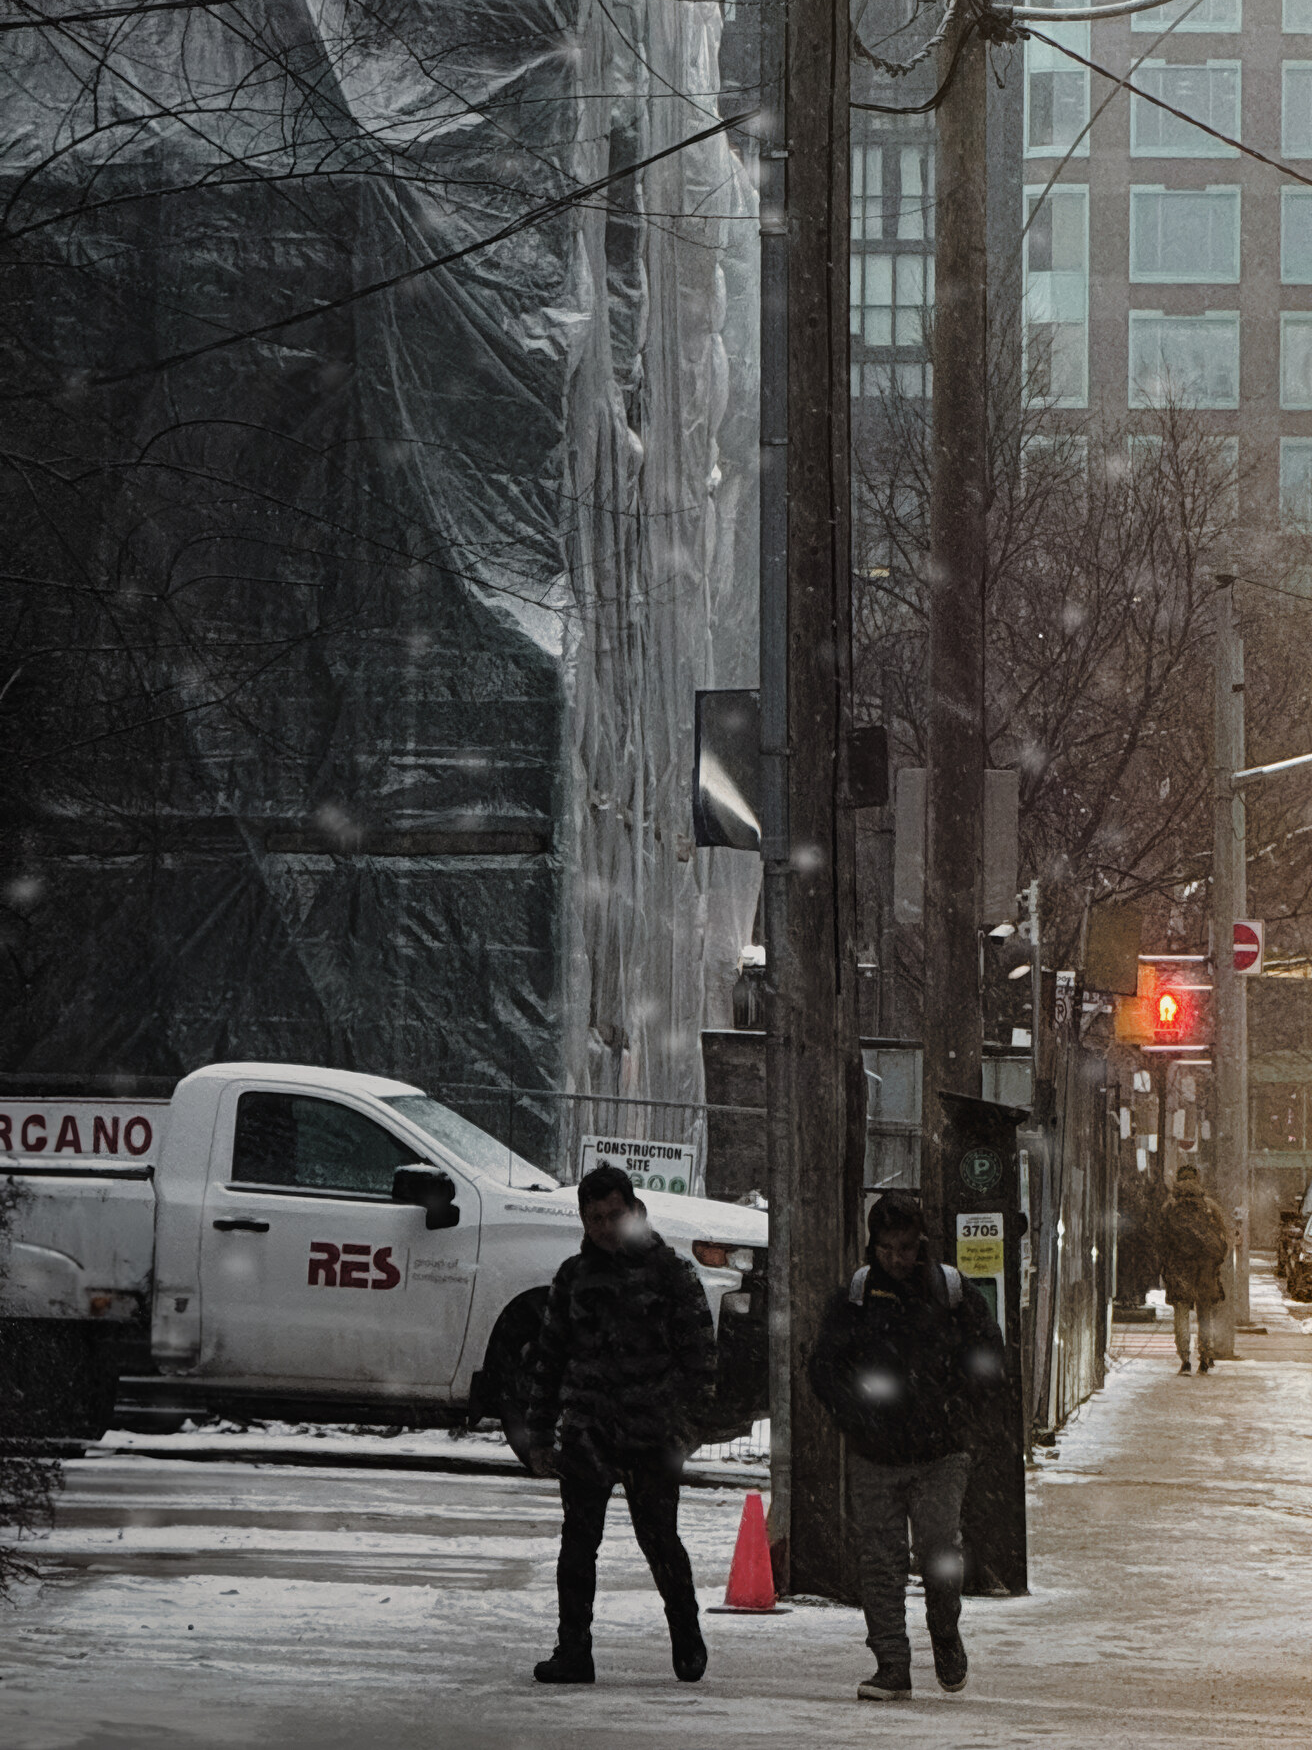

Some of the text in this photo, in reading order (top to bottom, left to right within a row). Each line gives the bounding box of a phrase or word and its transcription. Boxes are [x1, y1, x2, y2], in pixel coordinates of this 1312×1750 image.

[596, 1140, 682, 1161] CONSTRUCTION
[626, 1158, 650, 1172] SITE
[962, 1224, 999, 1237] 3705
[307, 1241, 401, 1290] RES
